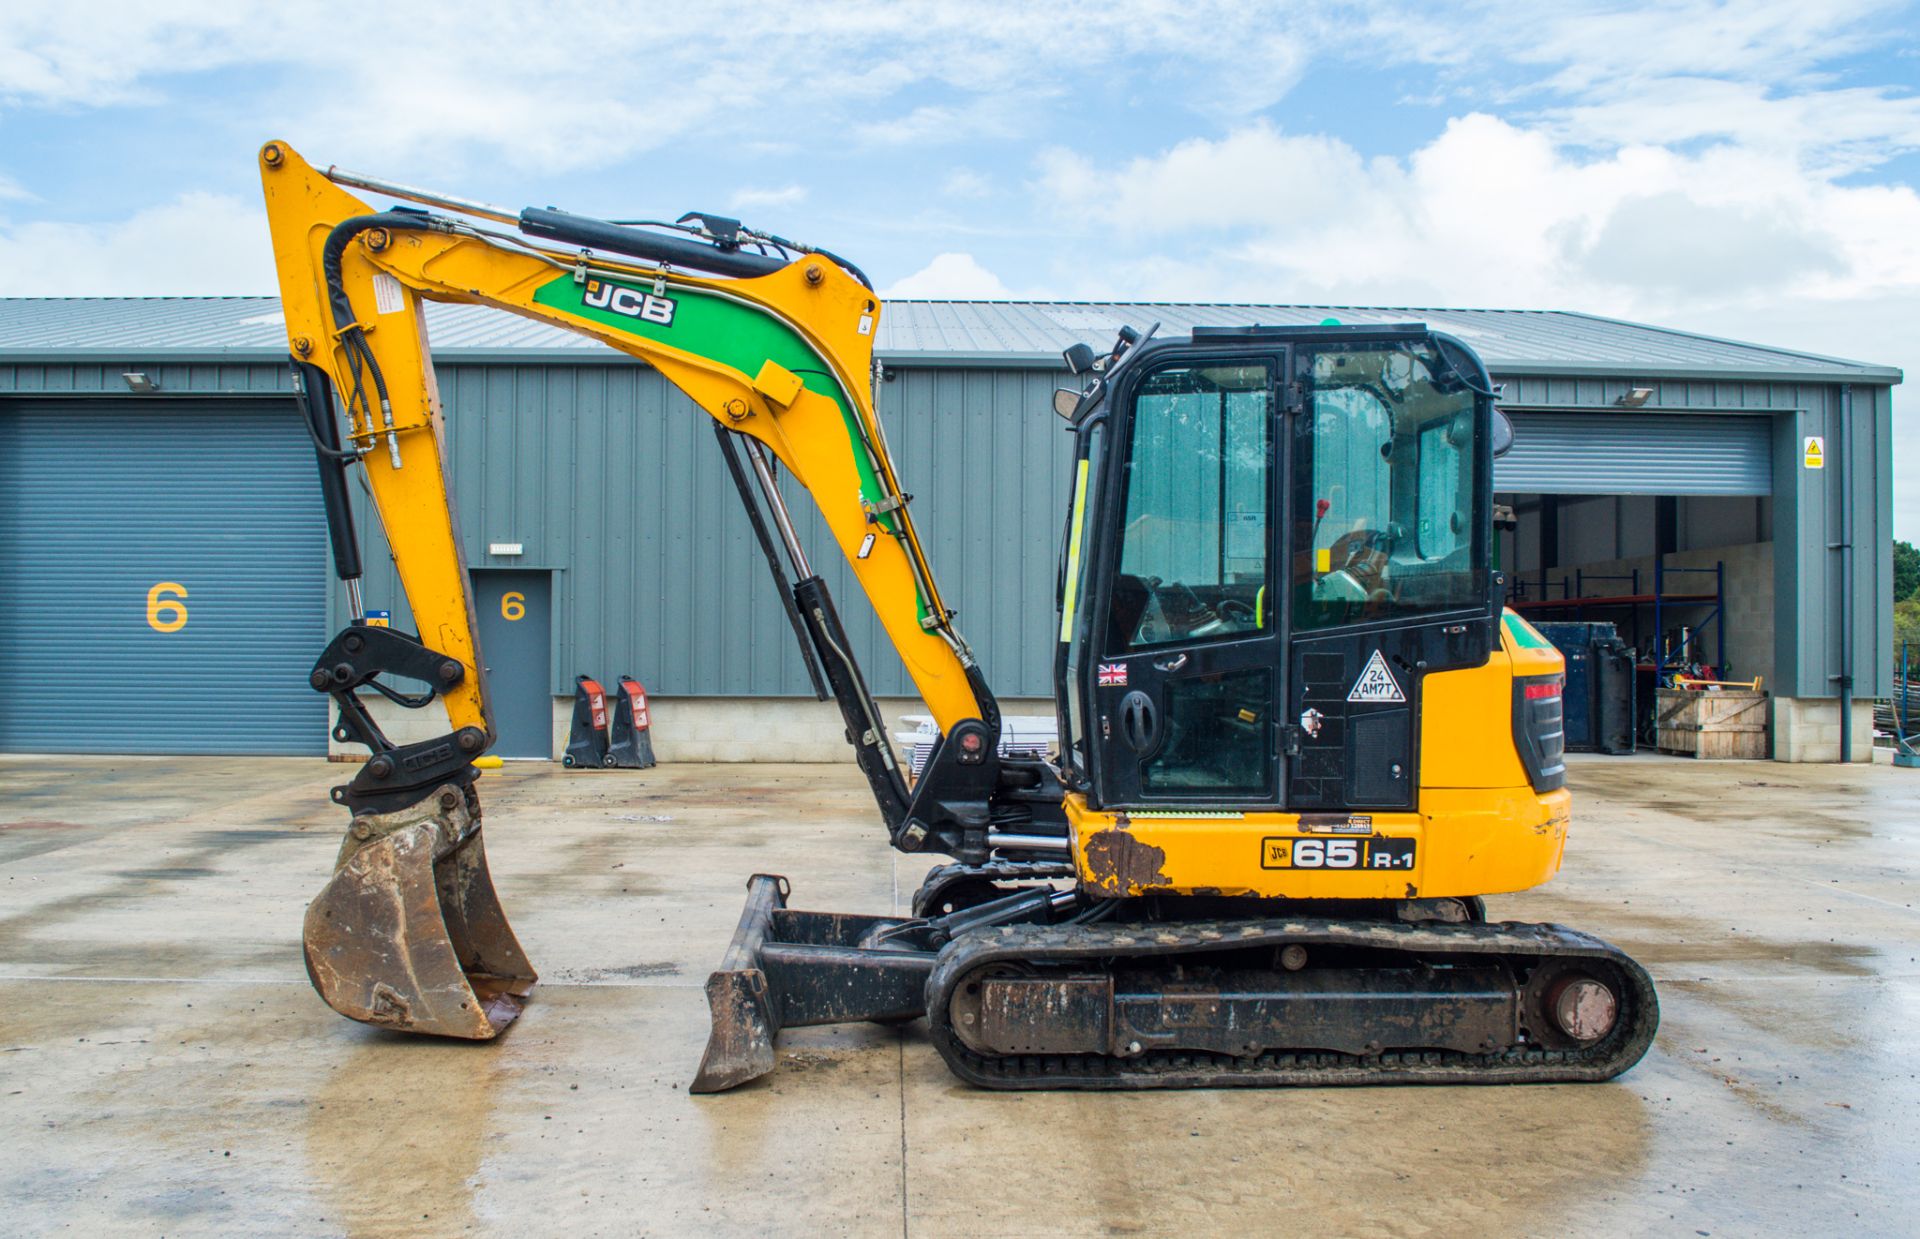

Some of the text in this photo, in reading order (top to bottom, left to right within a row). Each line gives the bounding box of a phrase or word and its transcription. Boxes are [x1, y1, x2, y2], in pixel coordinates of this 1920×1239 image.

[584, 283, 674, 324] JCB
[146, 581, 188, 633] 6
[502, 591, 526, 621] 6
[1361, 683, 1392, 695] AM7T
[1369, 670, 1384, 682] 24
[403, 743, 453, 771] JCB
[1271, 839, 1413, 868] JCB 65 R-1
